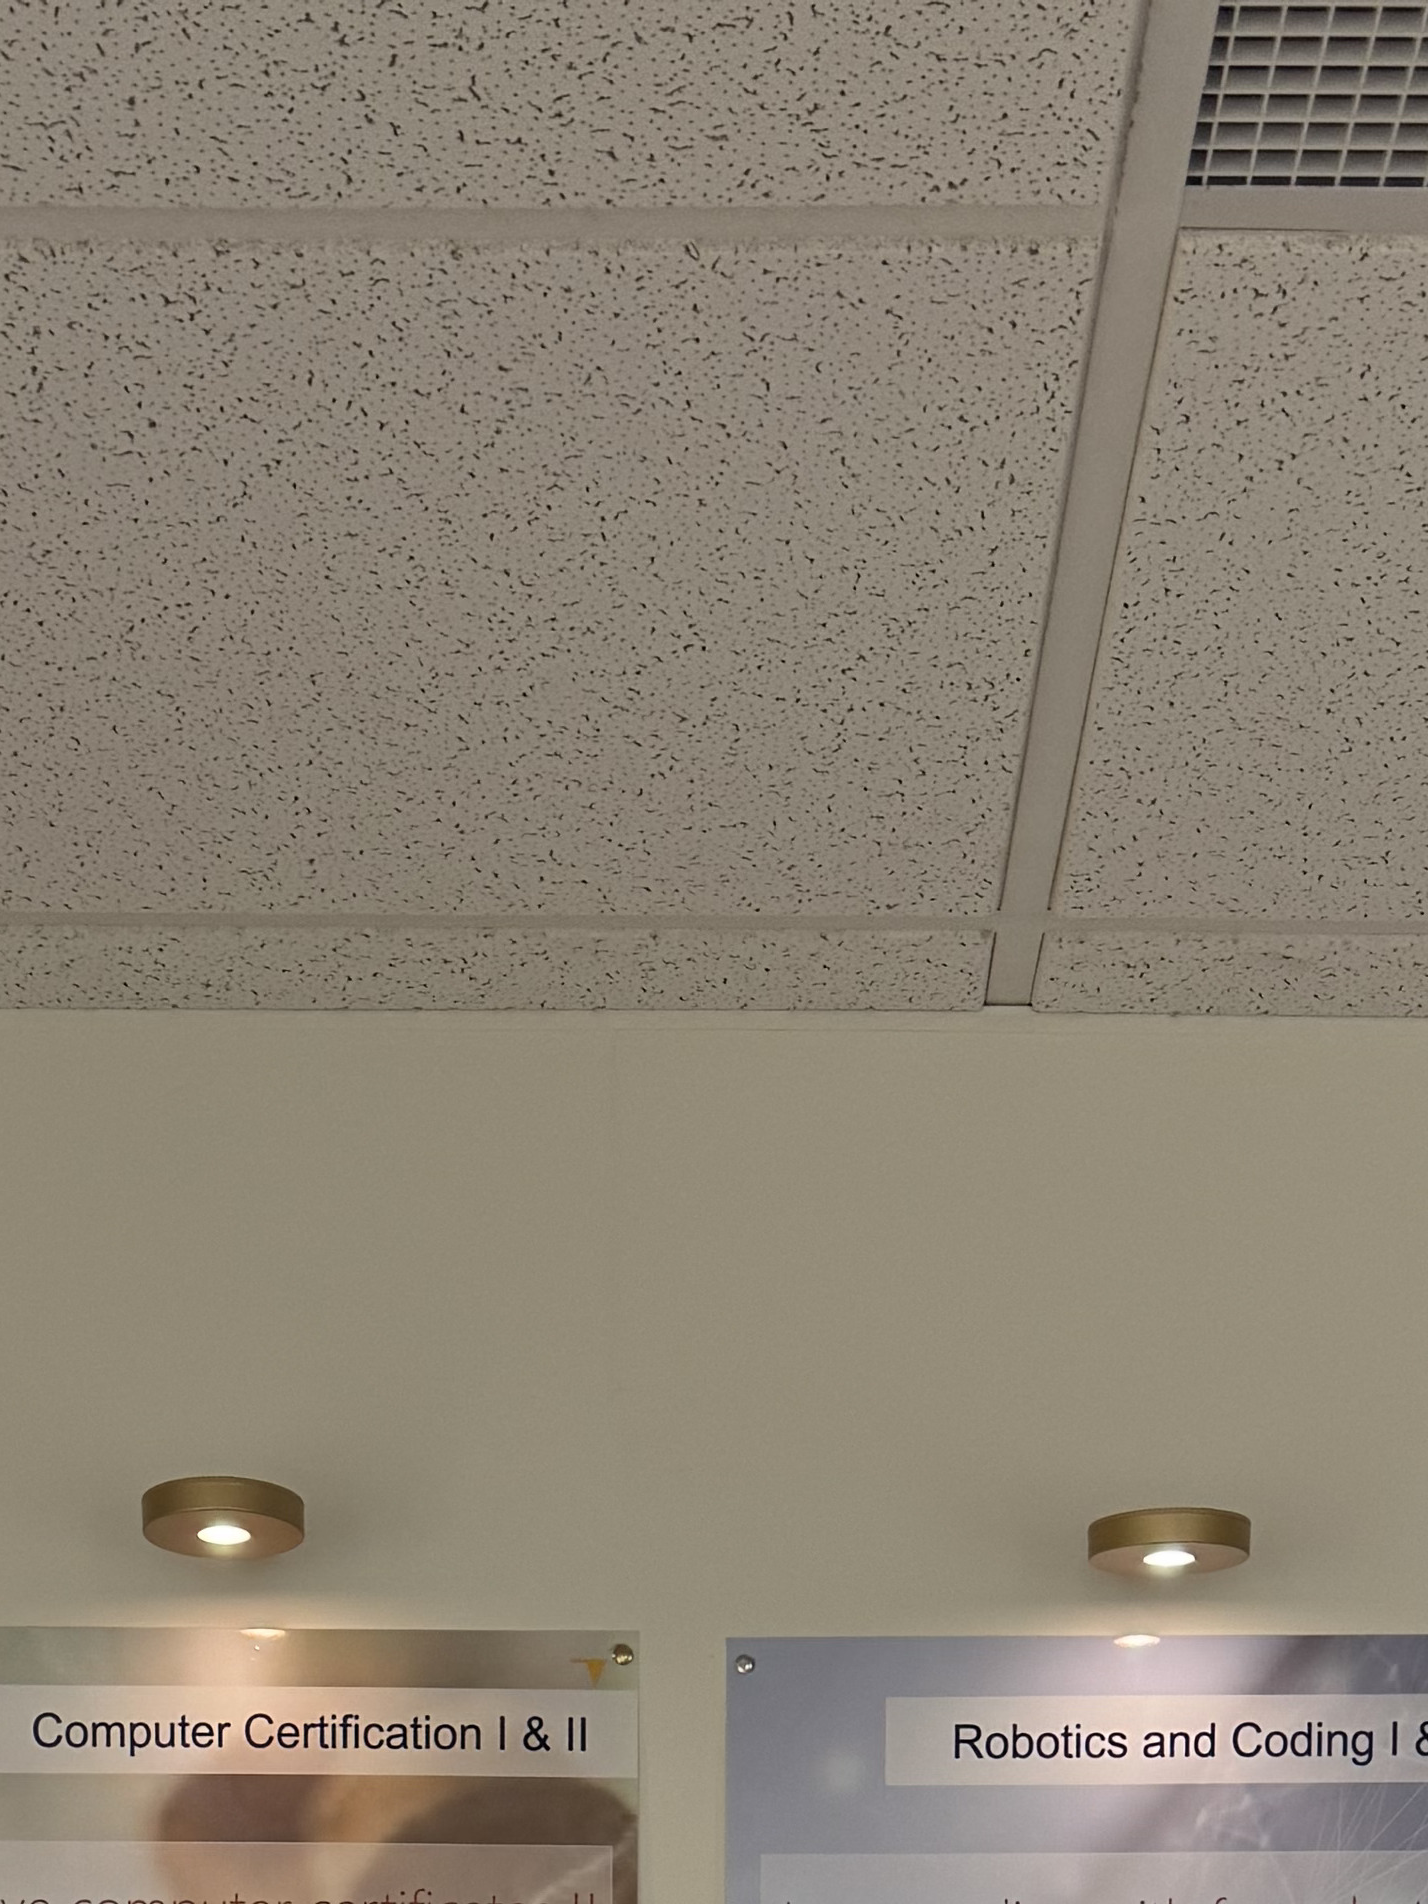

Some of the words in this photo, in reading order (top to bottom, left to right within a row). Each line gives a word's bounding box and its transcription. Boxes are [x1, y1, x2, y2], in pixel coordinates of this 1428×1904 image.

[32, 1712, 232, 1758] Computer
[244, 1712, 481, 1750] Certification
[499, 1715, 506, 1751] I
[522, 1715, 551, 1752] &
[567, 1716, 587, 1752] II
[954, 1723, 1128, 1760] Robotics
[1142, 1722, 1216, 1759] and
[1232, 1721, 1374, 1767] Coding
[1391, 1721, 1398, 1756] I
